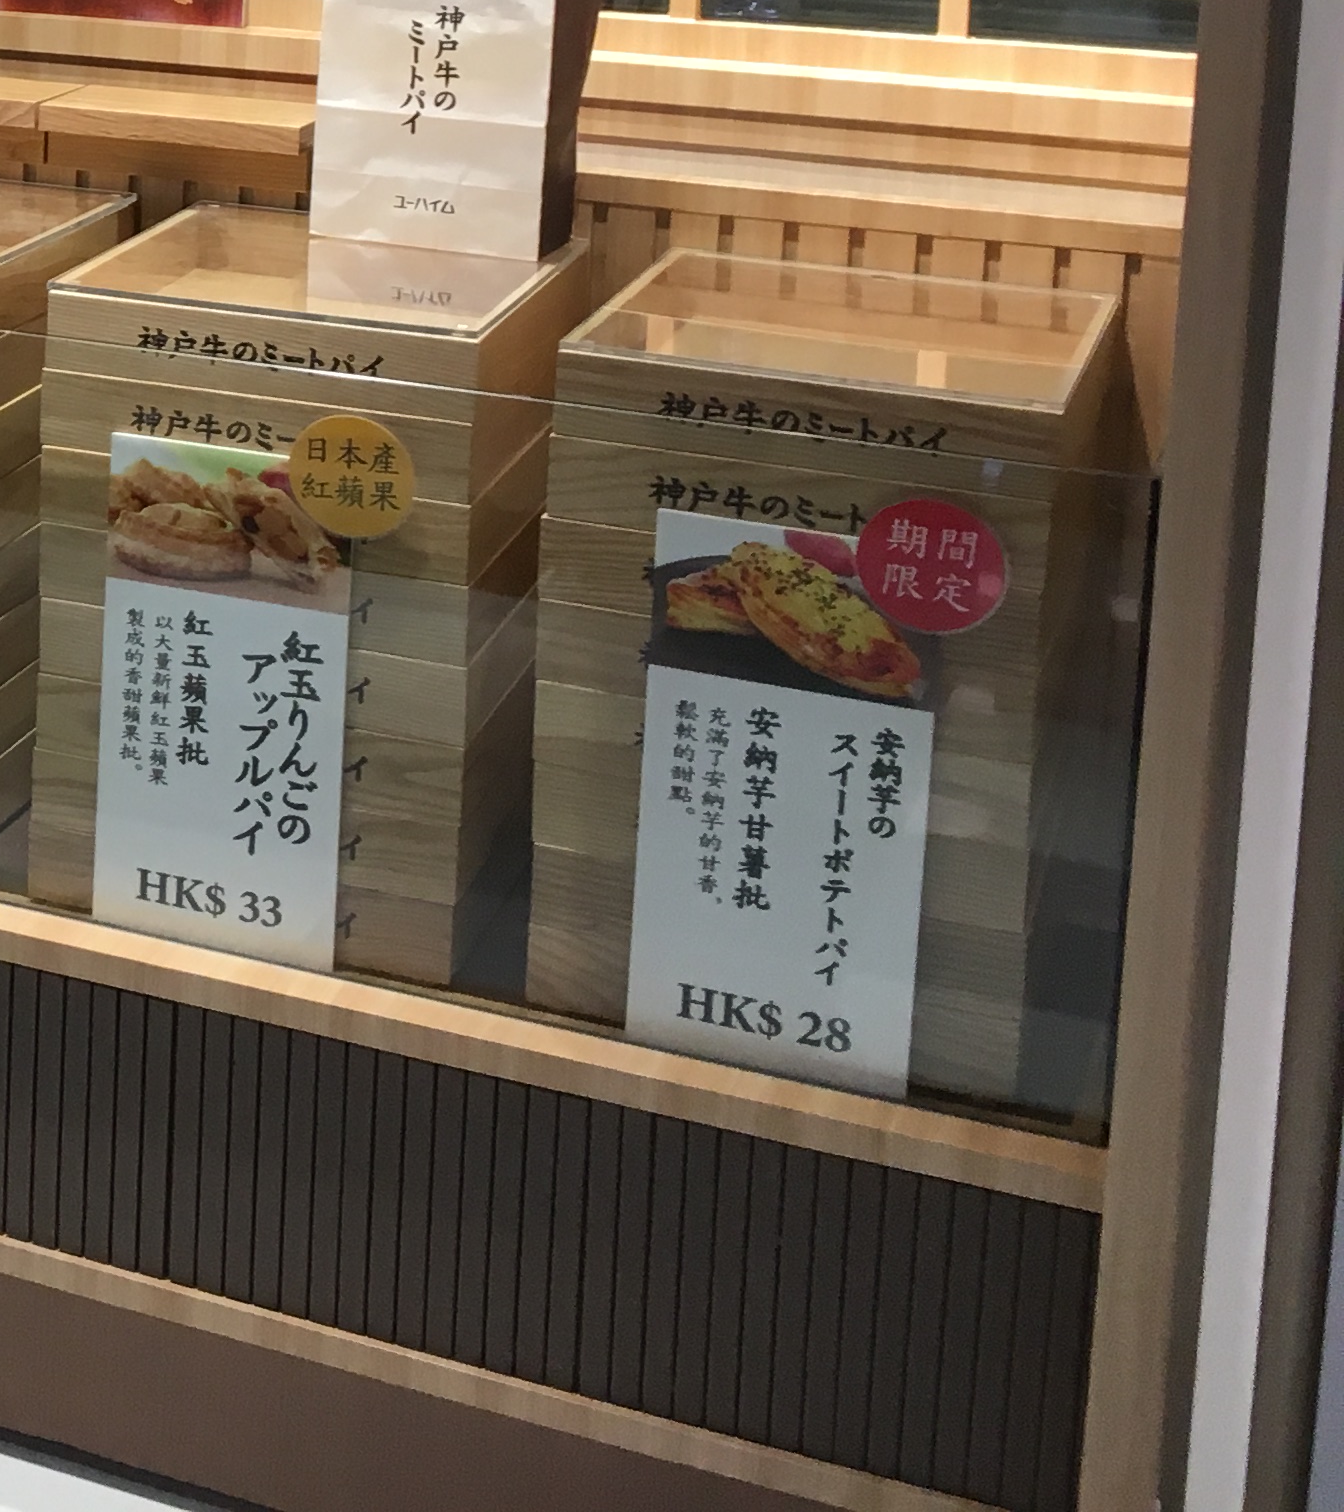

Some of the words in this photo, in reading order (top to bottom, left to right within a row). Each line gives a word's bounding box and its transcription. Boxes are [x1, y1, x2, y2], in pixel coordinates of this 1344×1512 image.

[401, 20, 426, 134] ミートパイ
[393, 194, 456, 215] ユーハイム
[301, 472, 401, 512] 紅蘋果
[882, 562, 971, 613] 限定
[887, 517, 979, 570] 期間
[175, 609, 214, 766] 紅玉蘋果批
[233, 653, 278, 856] アップルパイ
[277, 630, 324, 845] 紅玉りんごの
[867, 727, 906, 839] 安納芋の
[135, 867, 227, 919] HK$
[238, 891, 283, 928] 33
[814, 733, 859, 987] スイートポテトパイ
[676, 982, 784, 1040] HK$
[796, 1010, 853, 1054] 28
